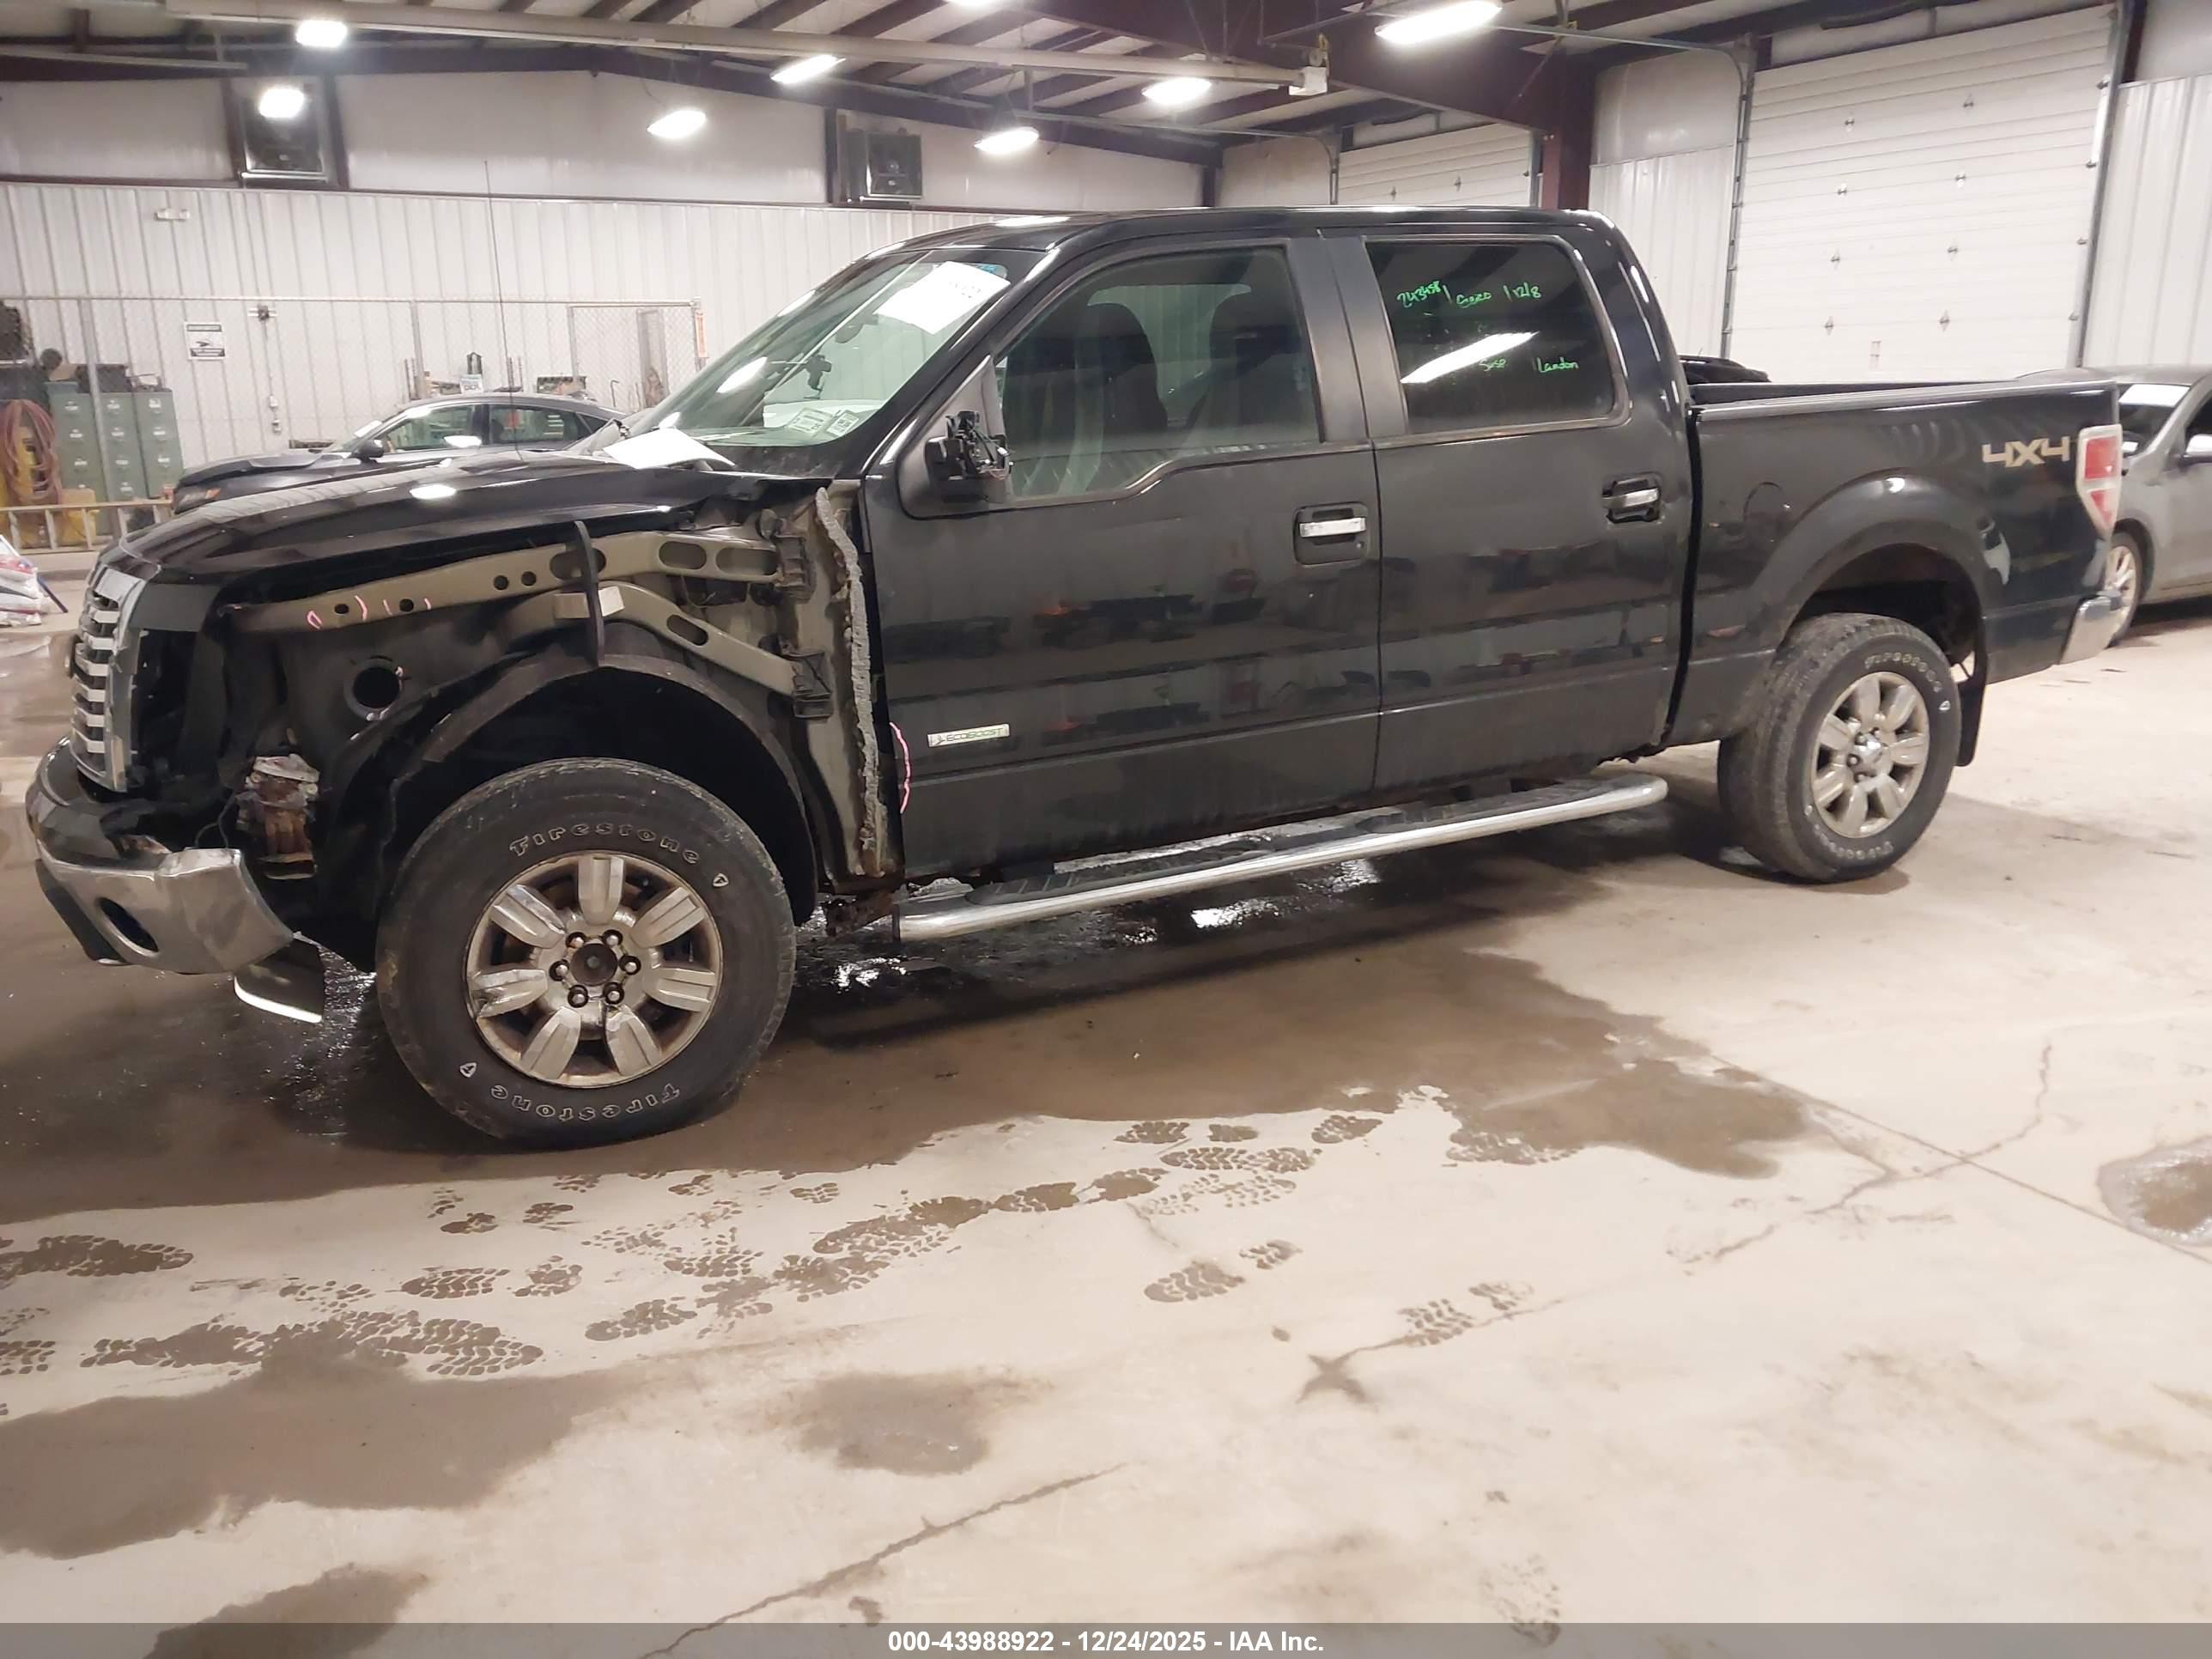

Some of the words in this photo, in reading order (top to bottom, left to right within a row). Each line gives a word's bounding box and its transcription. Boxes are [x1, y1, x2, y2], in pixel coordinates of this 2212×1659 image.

[1981, 435, 2070, 468] 4X4
[508, 823, 700, 864] Firestone
[490, 1083, 680, 1122] Firestone
